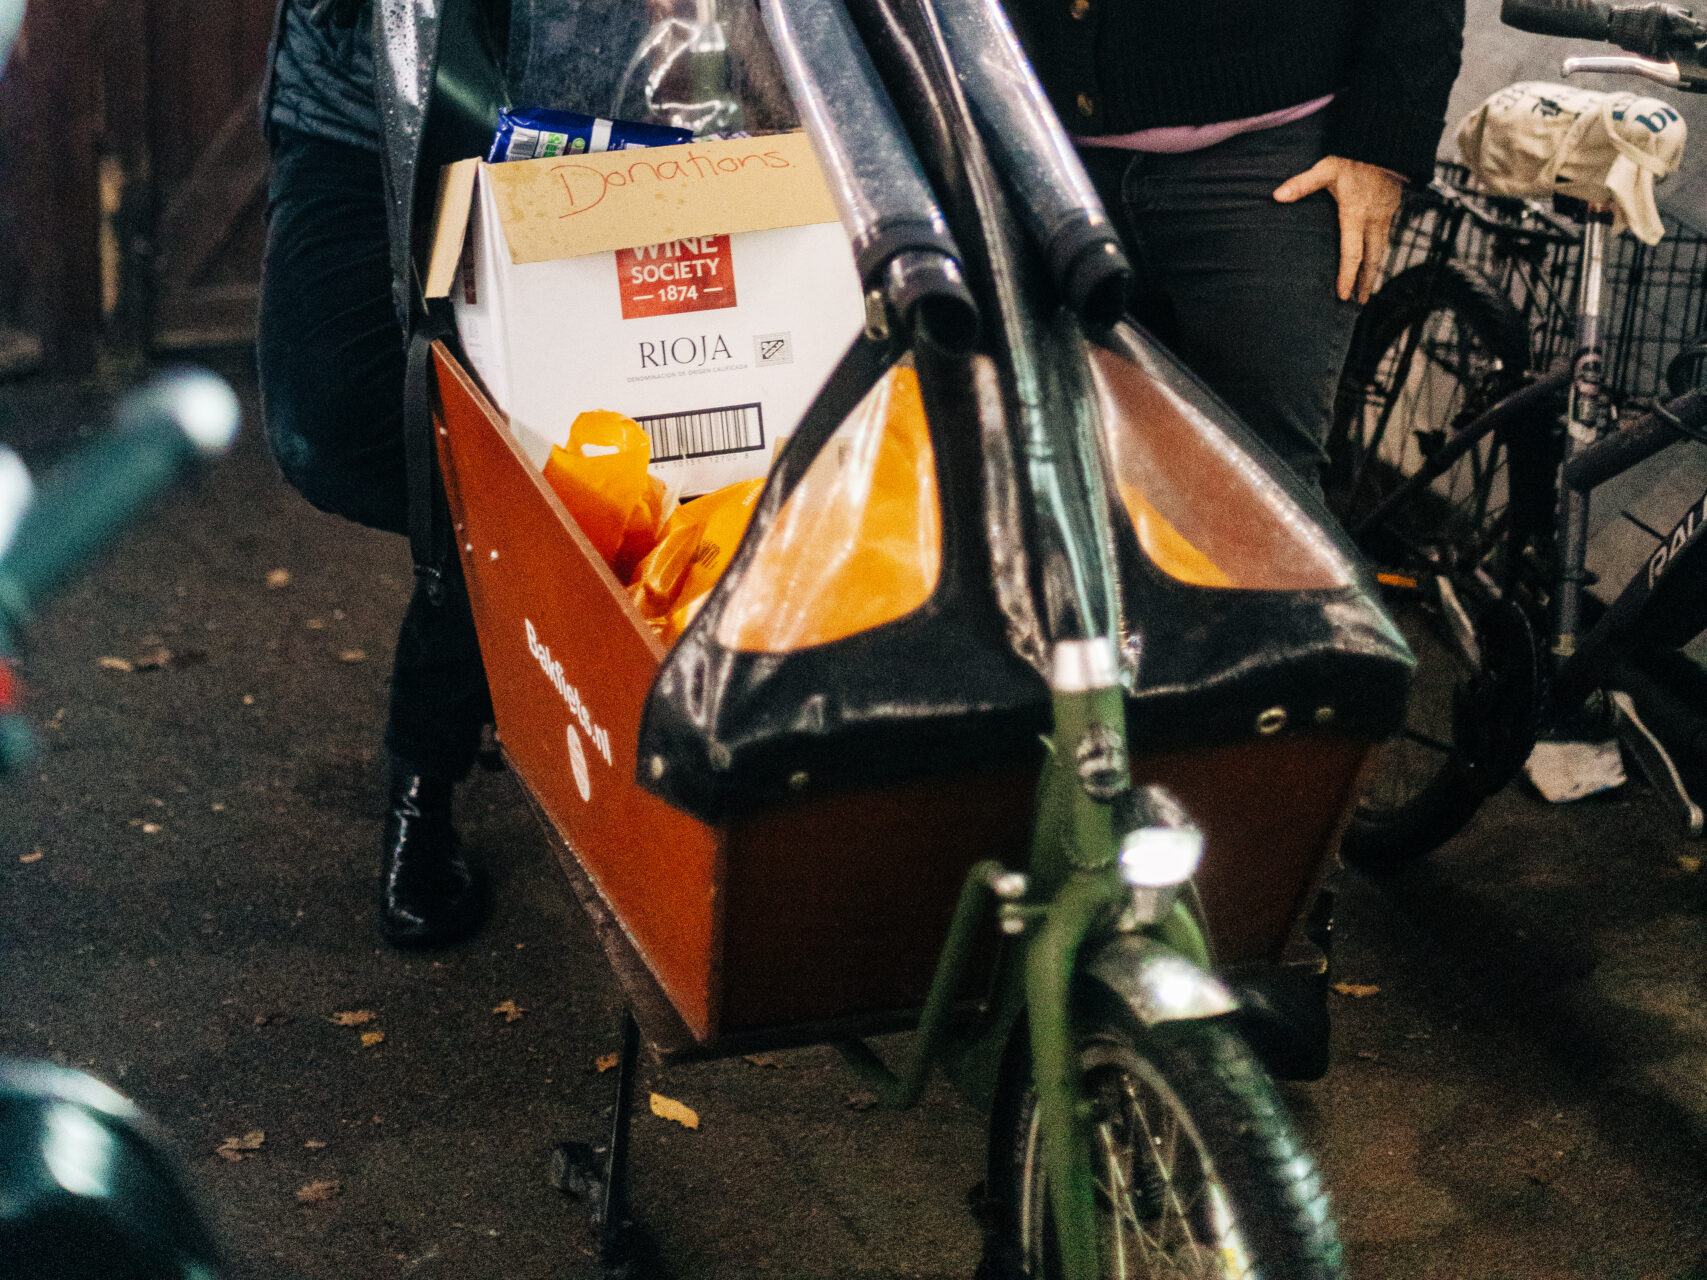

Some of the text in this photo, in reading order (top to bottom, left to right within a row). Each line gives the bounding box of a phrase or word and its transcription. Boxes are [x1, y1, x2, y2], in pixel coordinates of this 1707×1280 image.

[633, 235, 719, 261] WINE
[631, 257, 720, 284] SOCIETY
[658, 285, 698, 302] 1874
[639, 333, 733, 369] RIOJA
[524, 618, 613, 768] Bakfiets.nl
